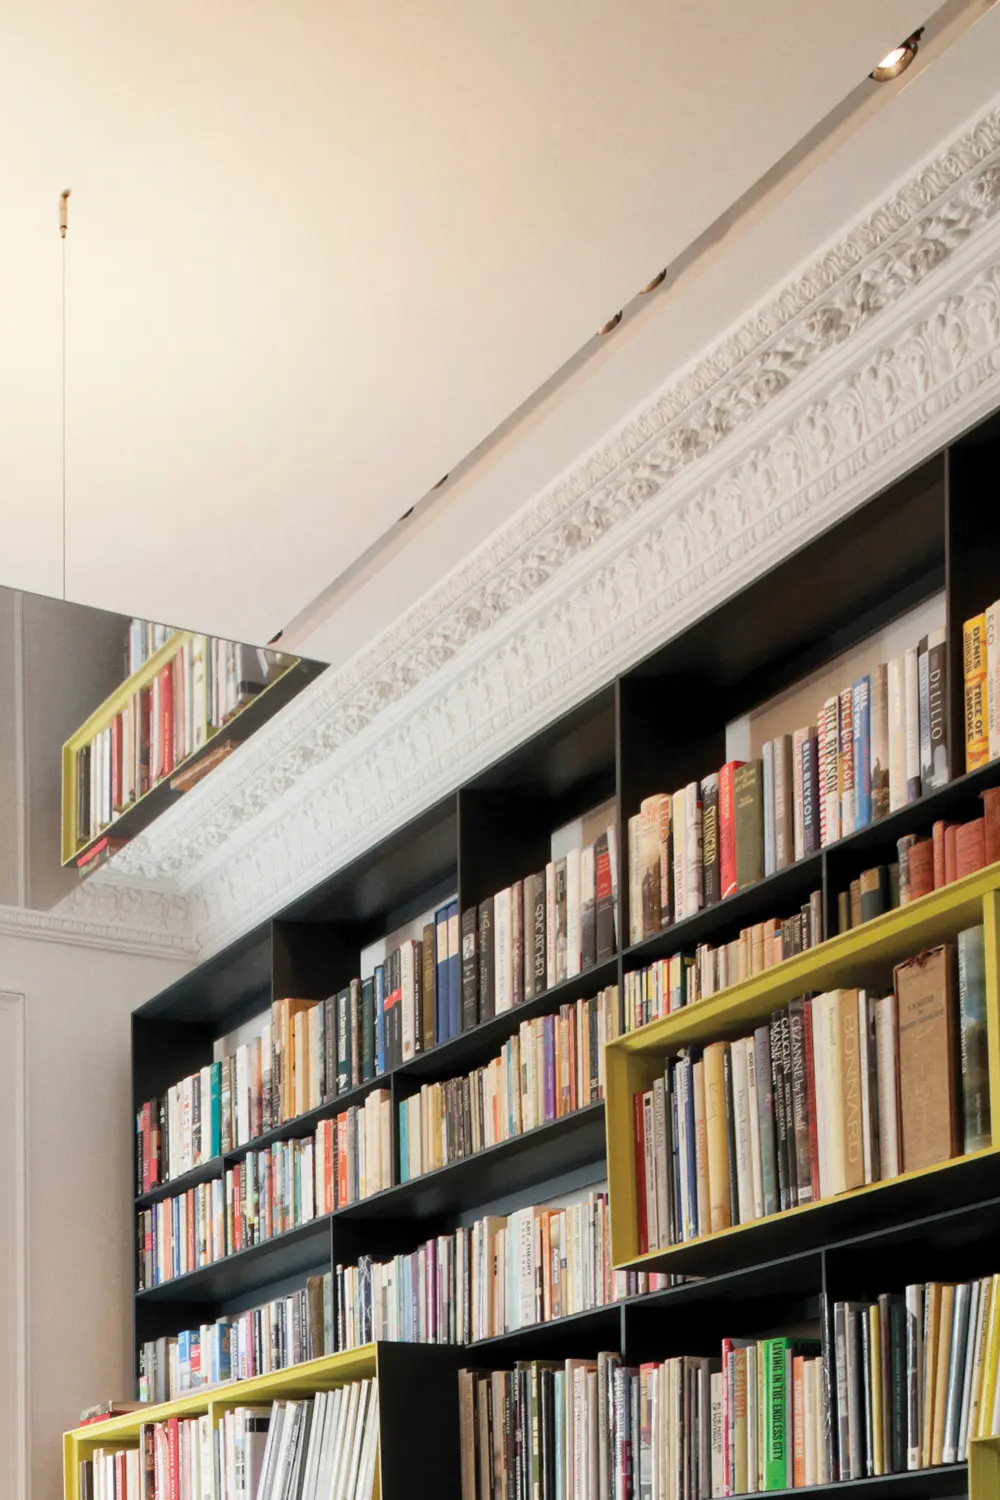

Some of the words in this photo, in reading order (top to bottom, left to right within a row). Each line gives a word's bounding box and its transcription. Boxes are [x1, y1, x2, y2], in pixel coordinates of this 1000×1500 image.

[973, 626, 981, 669] DENIS
[824, 702, 837, 738] BILL
[840, 690, 852, 729] BILL
[966, 686, 974, 742] SMOKE
[974, 684, 982, 718] TREE
[975, 720, 983, 737] OF
[801, 741, 810, 772] BILL
[824, 738, 838, 795] BRYSON
[841, 731, 853, 790] BRYSON
[803, 772, 812, 826] BRYSON
[702, 805, 716, 865] STALINGRAD
[773, 1020, 781, 1065] MANET
[781, 1017, 791, 1074] GAUGUIN
[793, 1079, 802, 1093] by
[843, 1014, 860, 1164] BONNARD
[654, 1086, 664, 1148] MONDRIAN
[772, 1342, 782, 1371] LIVING
[772, 1374, 782, 1383] IN
[772, 1386, 783, 1400] THE
[772, 1404, 783, 1440] ENDLESS
[773, 1442, 783, 1461] CITY
